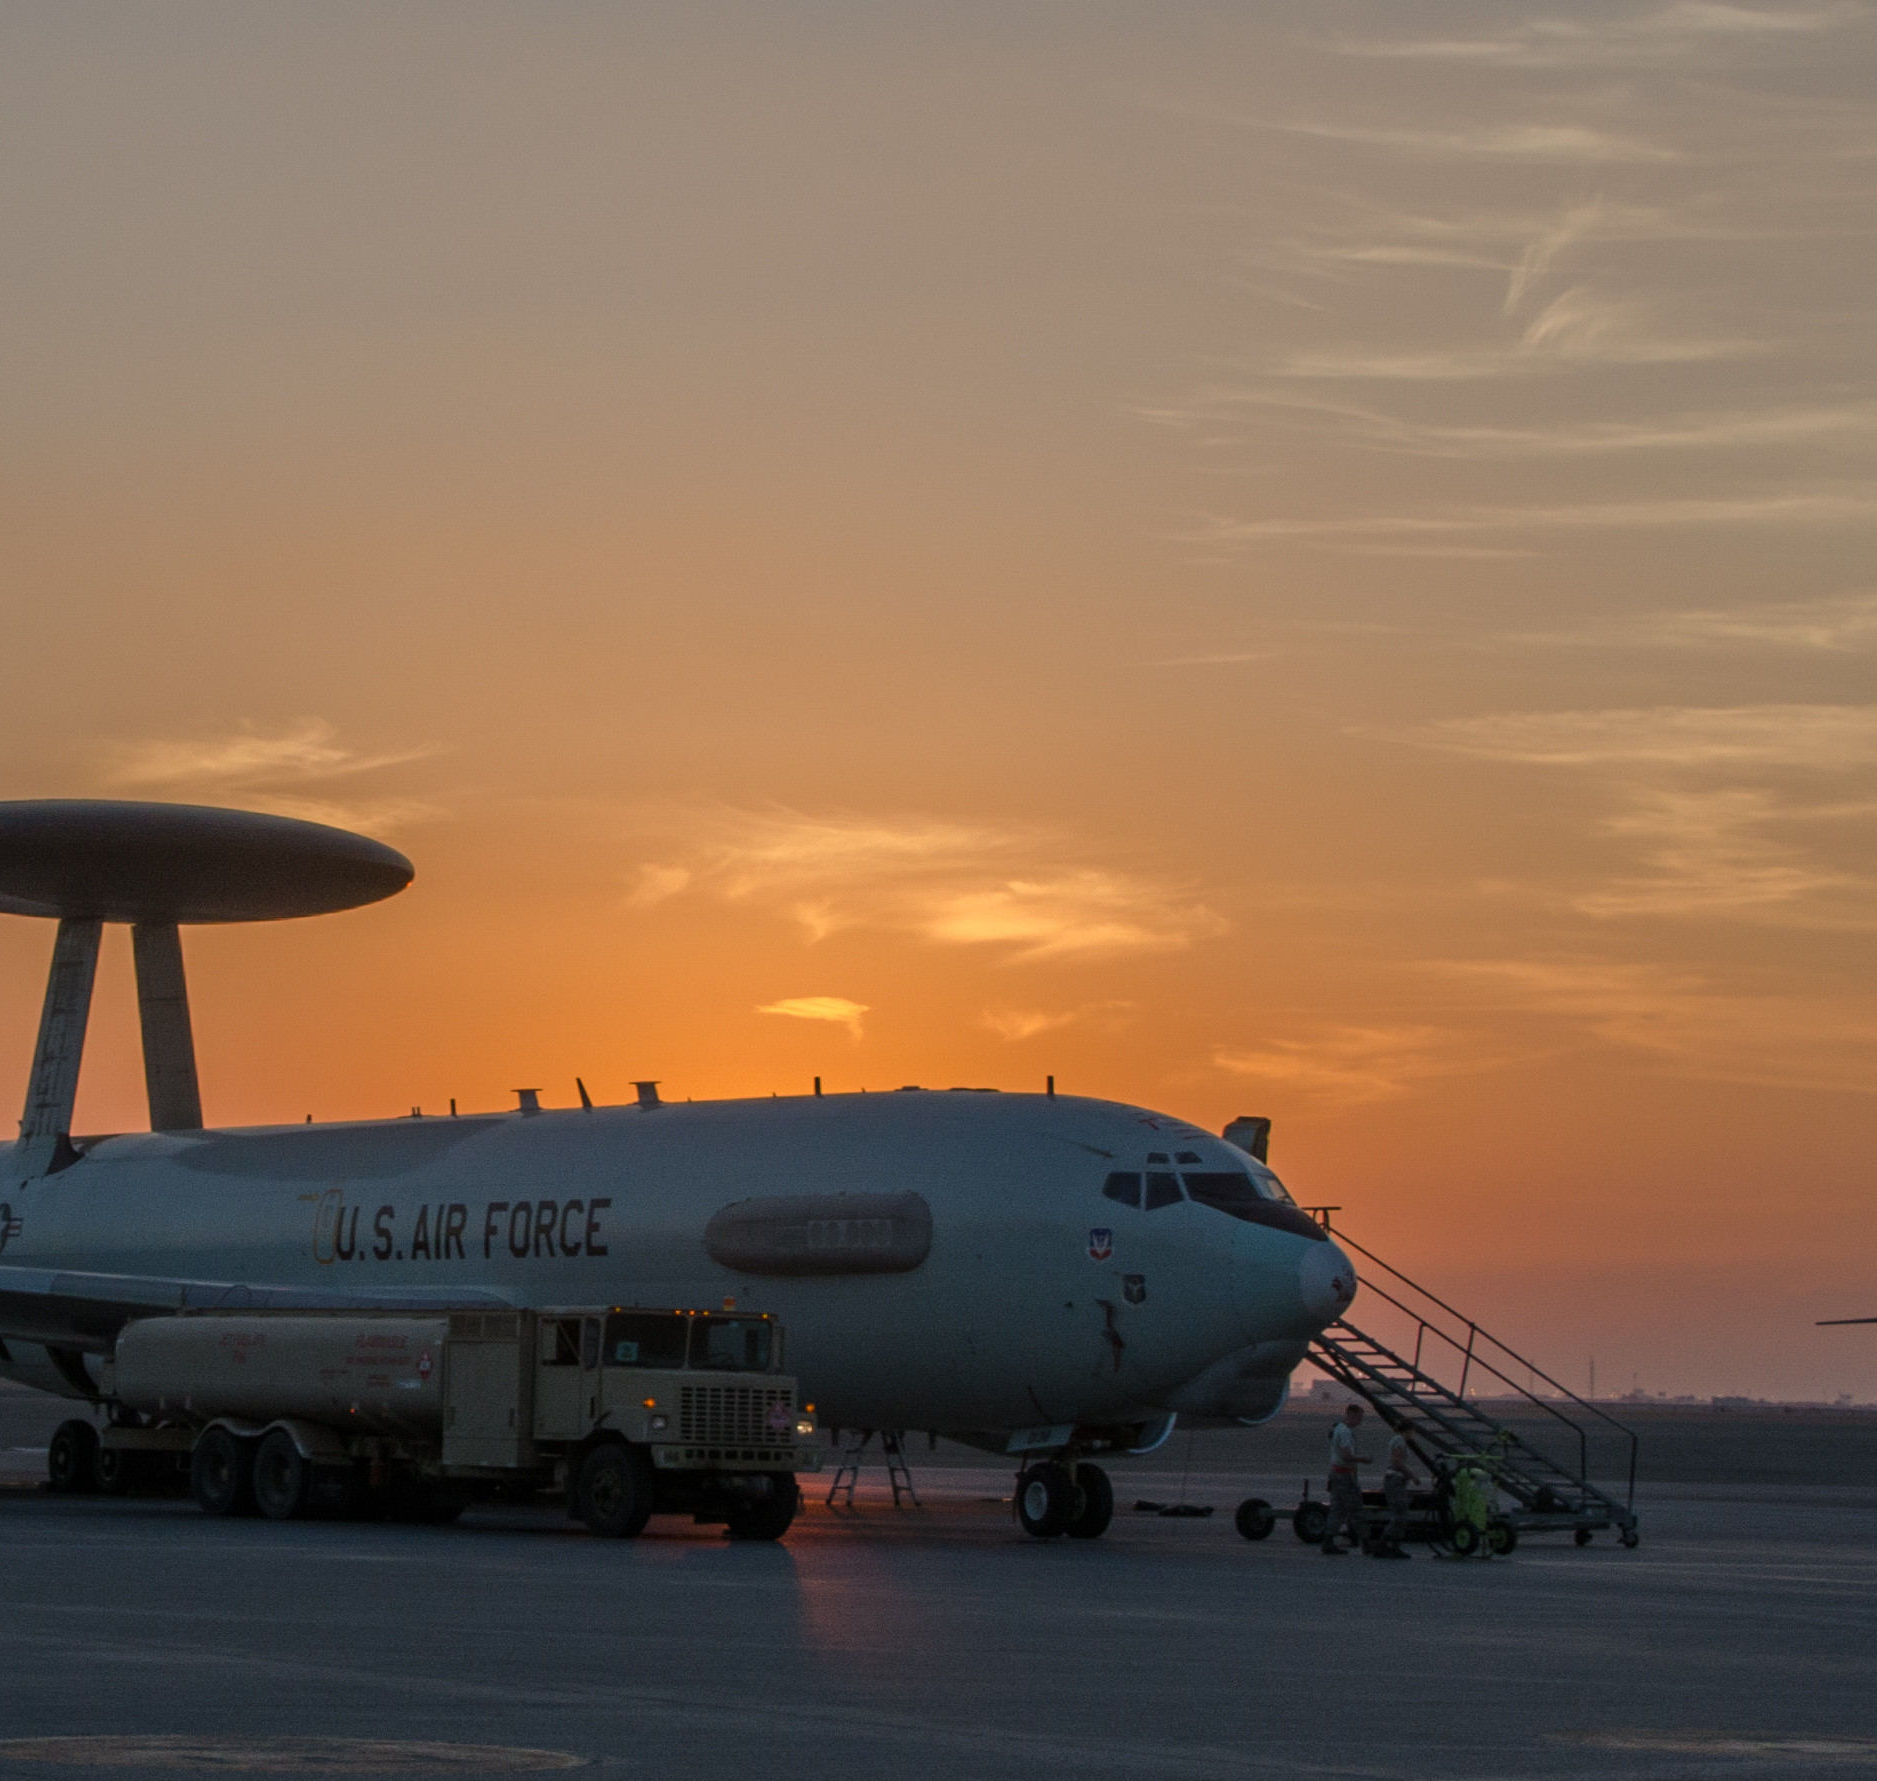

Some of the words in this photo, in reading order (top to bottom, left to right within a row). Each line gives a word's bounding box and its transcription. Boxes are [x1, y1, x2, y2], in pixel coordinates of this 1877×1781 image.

[336, 1205, 403, 1261] U.S.
[411, 1203, 469, 1260] AIR
[483, 1198, 613, 1259] FORCE
